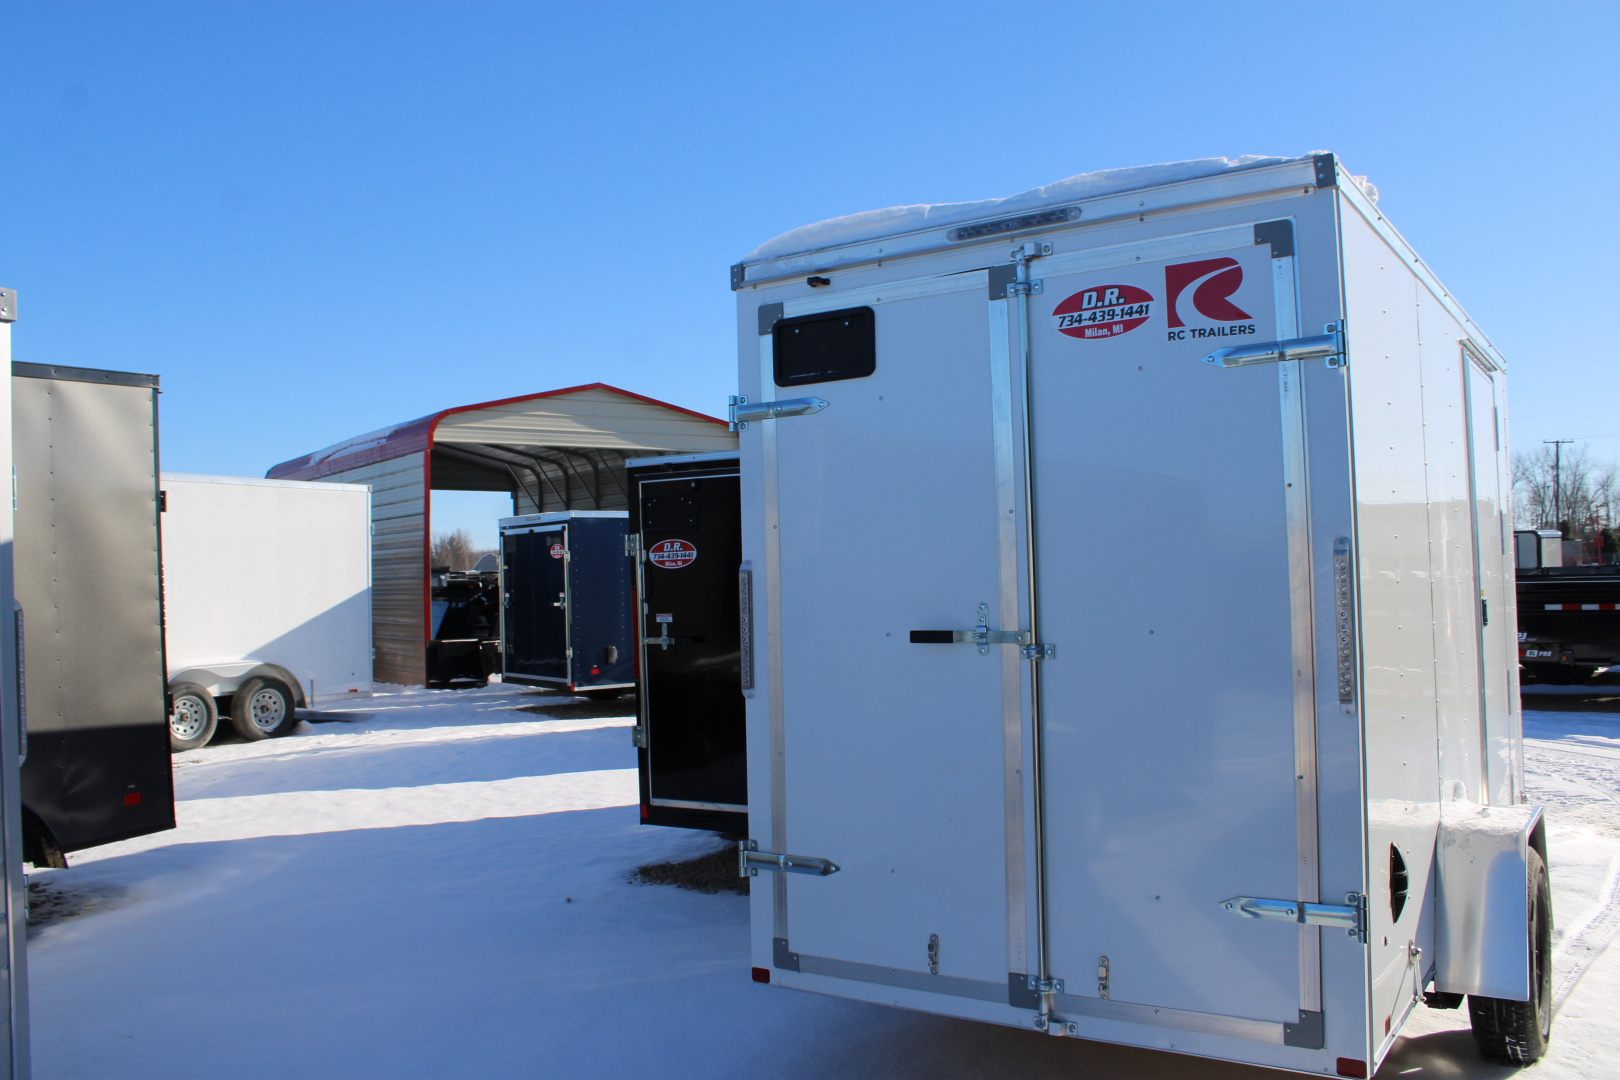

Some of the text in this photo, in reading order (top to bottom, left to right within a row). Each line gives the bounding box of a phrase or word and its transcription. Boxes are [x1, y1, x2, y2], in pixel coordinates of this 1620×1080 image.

[1081, 287, 1127, 310] D.R.
[1058, 303, 1150, 328] 734-439-1441
[1084, 324, 1124, 338] Milan, MI
[1168, 324, 1256, 342] RC TRAILERS
[663, 542, 683, 552] D.R.
[653, 552, 694, 560] 734-439-1441
